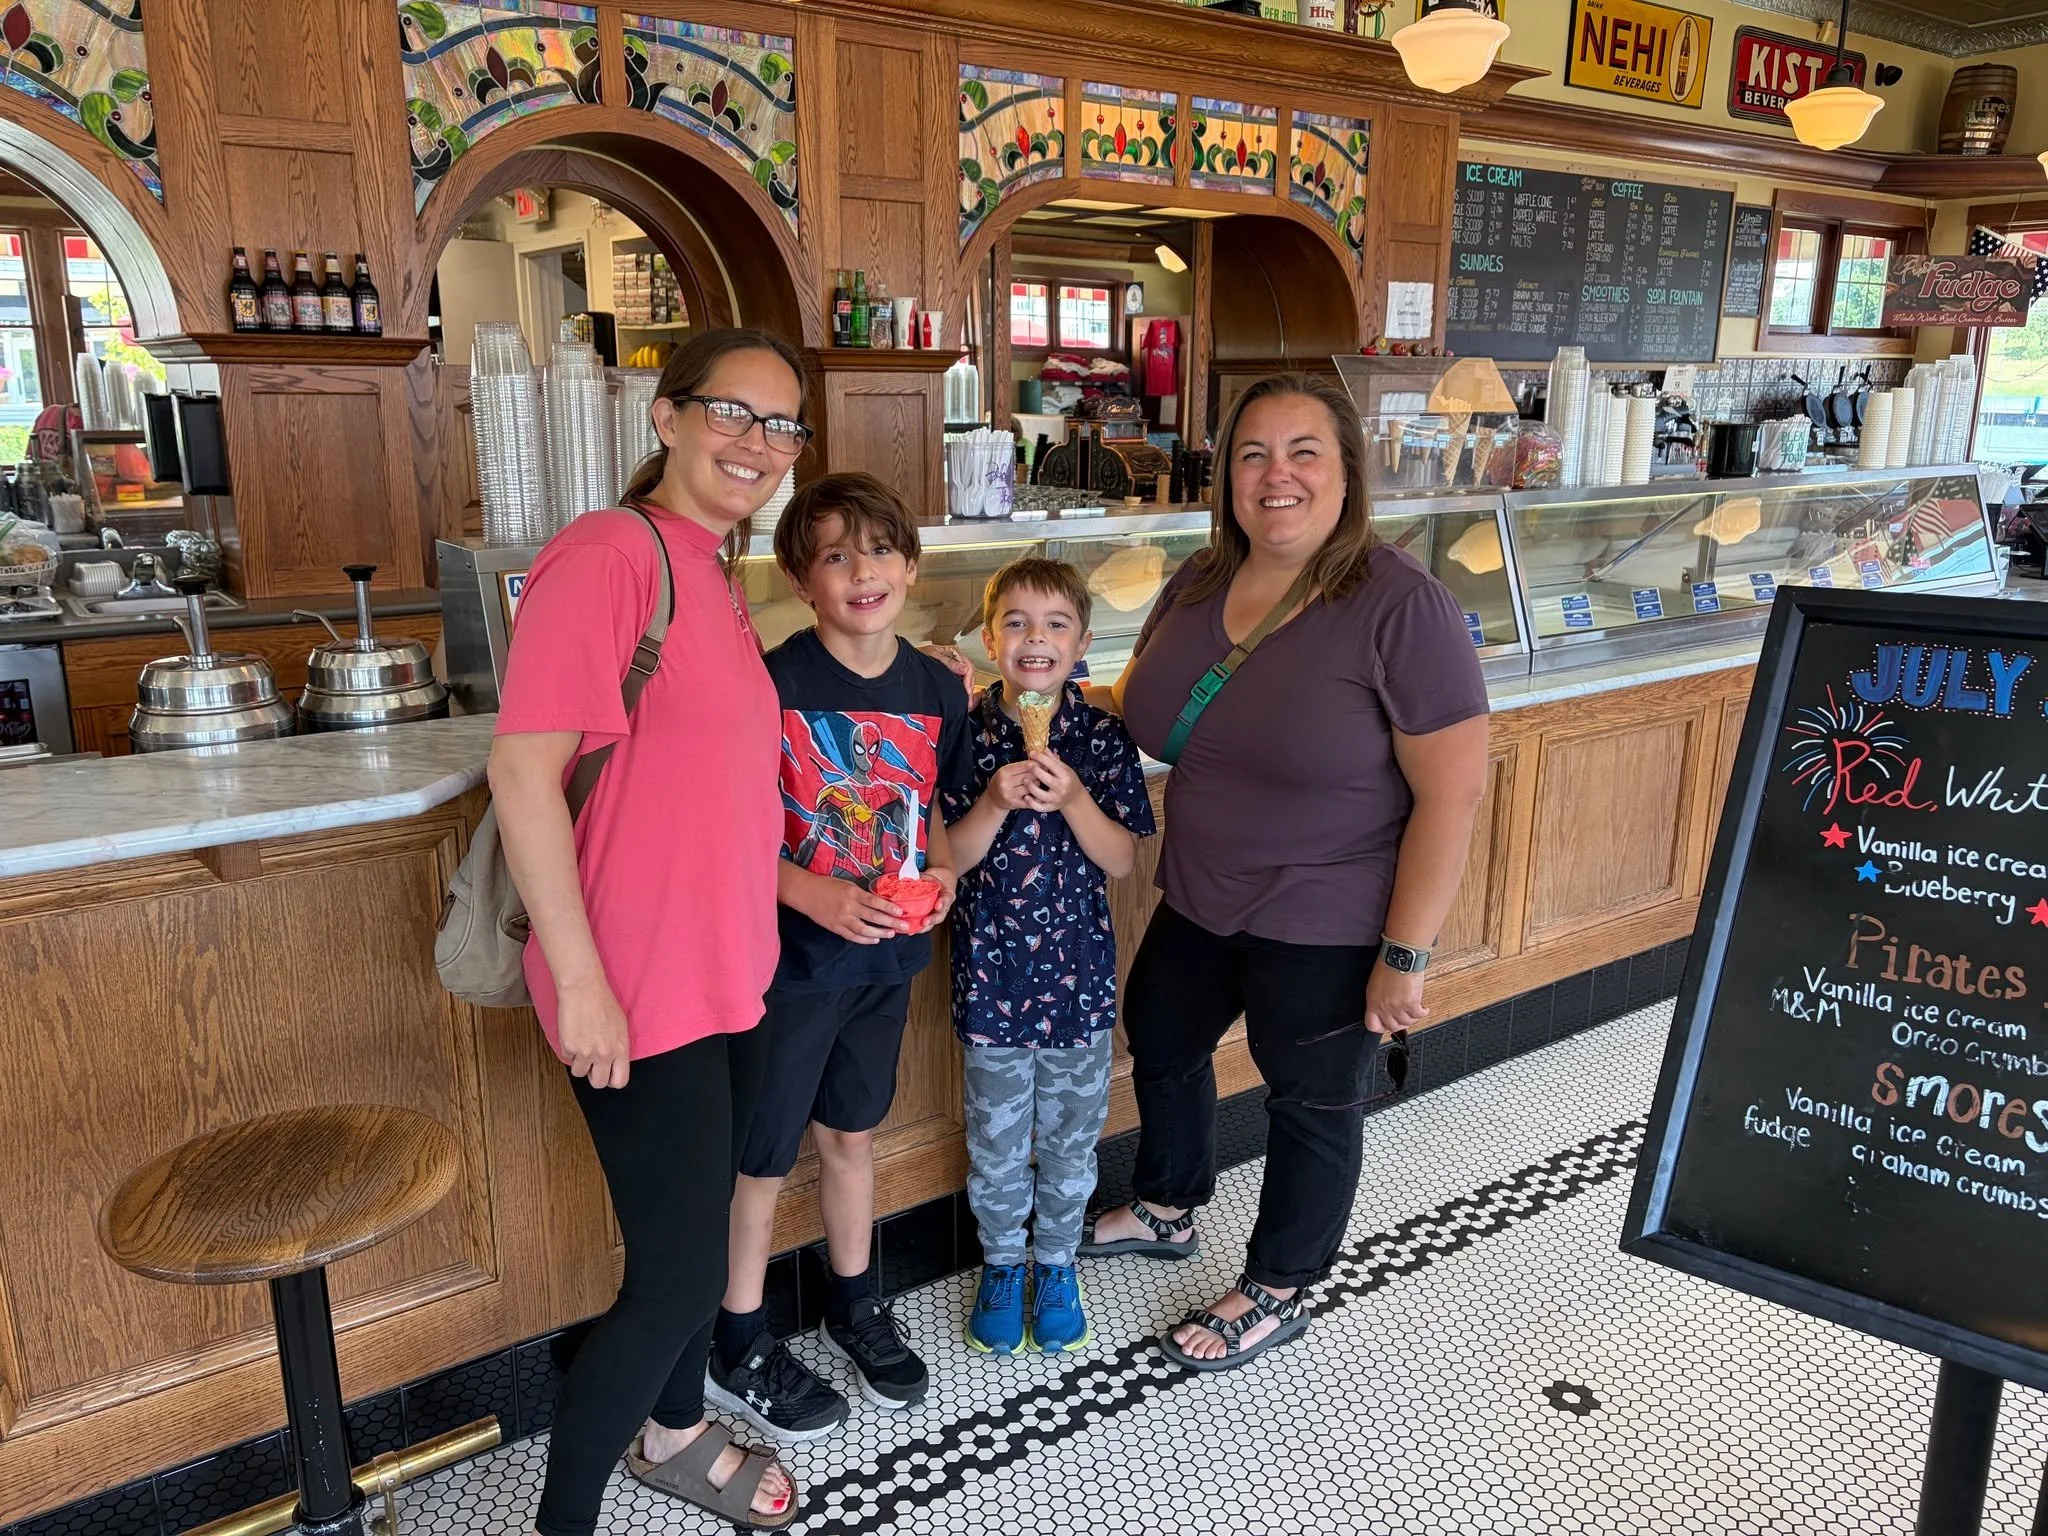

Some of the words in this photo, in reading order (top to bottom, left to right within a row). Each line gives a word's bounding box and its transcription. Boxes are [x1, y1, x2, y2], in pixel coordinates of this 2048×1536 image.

[1587, 0, 1604, 9] DRINK
[1282, 10, 1297, 24] BOT
[1309, 6, 1335, 19] Hire
[1580, 11, 1667, 77] NEHI
[1748, 43, 1823, 94] KIST
[1613, 74, 1662, 93] BEVERAGES
[1466, 164, 1484, 182] ICE
[1488, 166, 1523, 187] CREAM
[1467, 189, 1485, 202] SCOOP
[1611, 181, 1644, 200] COFFEE
[1514, 192, 1537, 207] WAFFLE
[1537, 194, 1553, 209] CONE
[1466, 203, 1485, 217] SCOOP
[1513, 208, 1534, 222] DIPPED
[1535, 209, 1557, 224] WAFFLE
[1589, 209, 1606, 220] COFFEE
[1663, 205, 1680, 216] COFFEE
[1465, 218, 1484, 231] SCOOP
[1512, 221, 1536, 235] SHAKES
[1589, 219, 1605, 229] MOCHA
[1662, 216, 1678, 226] MOCHA
[1462, 230, 1482, 245] SCOOP
[1588, 230, 1604, 241] LATTE
[1661, 226, 1677, 237] LATTE
[1511, 235, 1532, 248] MALTS
[1587, 242, 1614, 253] AMERICANO
[1660, 236, 1673, 246] CHAI
[1460, 253, 1504, 273] SUNDAES
[1586, 251, 1611, 262] ESPRESSO
[1657, 257, 1673, 267] MOCHA
[1657, 267, 1673, 277] LATTE
[1463, 288, 1479, 298] SCOOP
[1918, 261, 2020, 312] Fudge
[1513, 290, 1531, 301] BANANA
[1532, 291, 1545, 301] SPLIT
[1581, 285, 1630, 303] SMOOTHIES
[1647, 288, 1666, 305] SODA
[1670, 289, 1704, 306] FOUNTAIN
[1461, 298, 1479, 309] SCOOP
[1512, 301, 1534, 312] BROWNIE
[1536, 302, 1555, 313] SUNDAE
[1460, 309, 1478, 320] SCOOP
[1511, 312, 1528, 323] TURTLE
[1530, 313, 1548, 323] SUNDAE
[1893, 313, 1915, 321] Made
[1916, 313, 1938, 322] With
[1939, 313, 1958, 323] Real
[1958, 314, 1982, 323] Cream
[1984, 314, 1993, 323] &
[1993, 314, 2018, 323] Butter
[1510, 322, 1527, 333] COOKIE
[1528, 323, 1547, 334] SUNDAE
[1848, 643, 2036, 718] JULY
[1946, 765, 2048, 814] Whit
[1858, 826, 1937, 863] Vanilla
[1947, 845, 1979, 868] ice
[1985, 852, 2048, 879] crea
[1846, 912, 2028, 999] Pirates
[1803, 966, 1893, 1012] Vanilla
[1903, 996, 1939, 1024] ice
[1769, 986, 1842, 1027] M&M
[1892, 1022, 1959, 1055] Oreo
[1786, 1086, 1872, 1134] Vanilla
[1889, 1117, 1927, 1143] ice
[1744, 1104, 1811, 1151] fudge
[1956, 1176, 2048, 1220] crumbs
